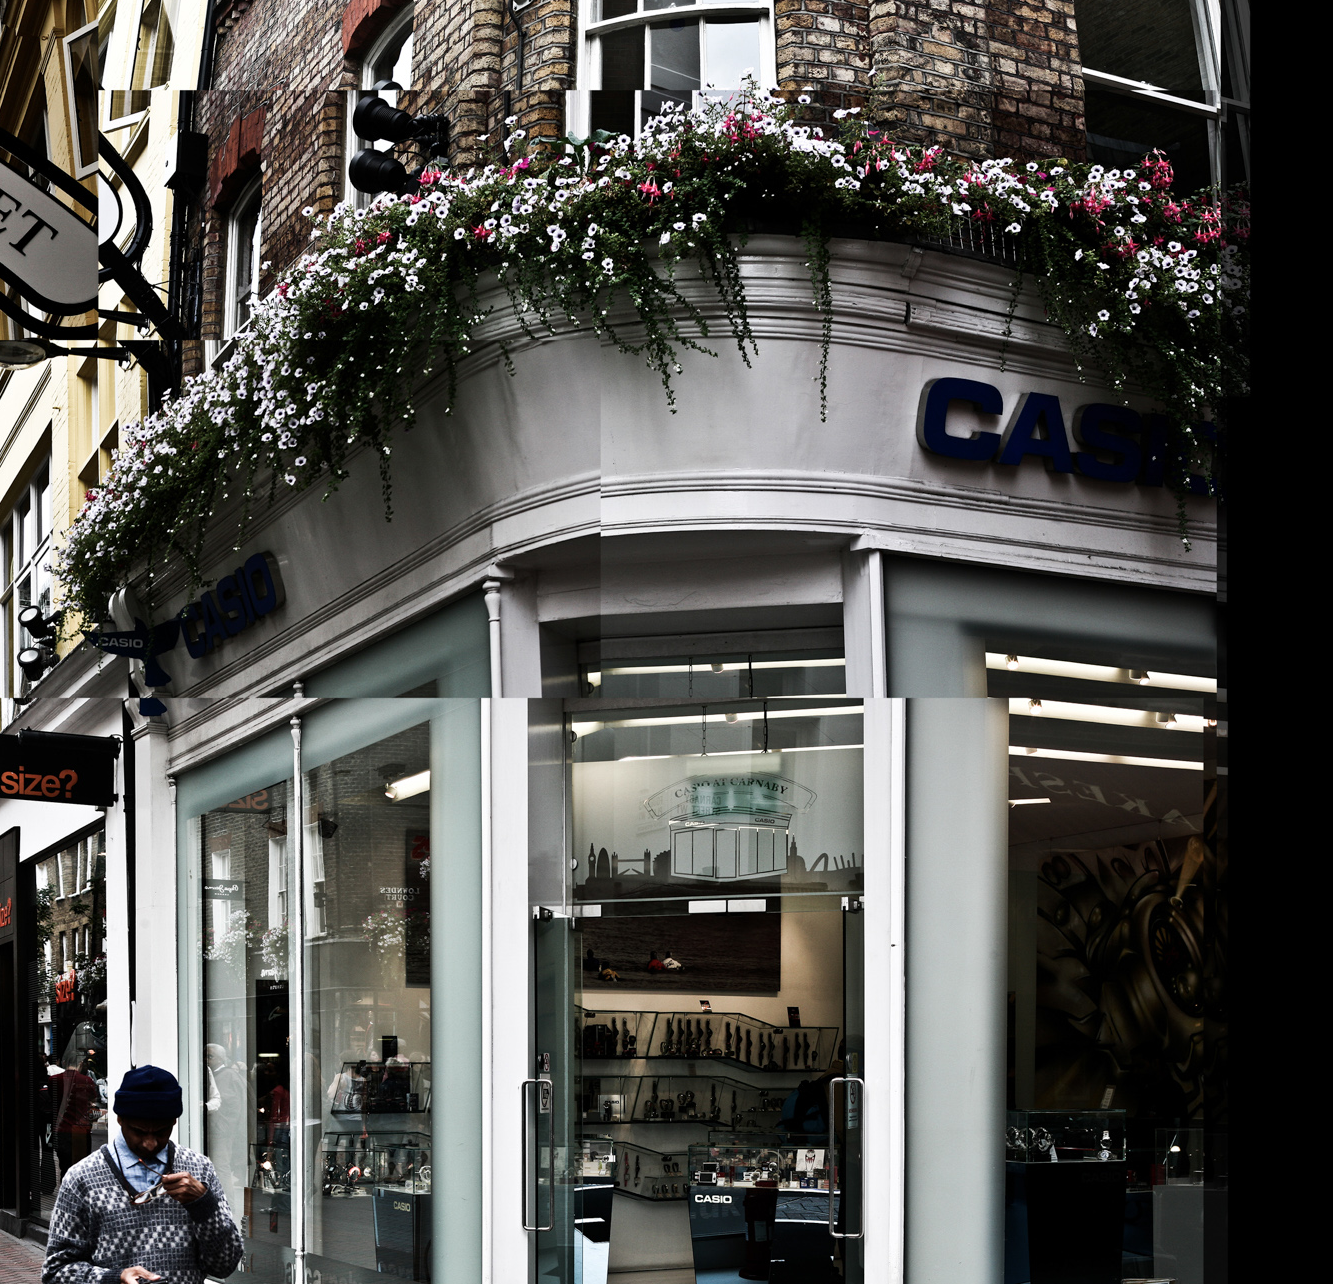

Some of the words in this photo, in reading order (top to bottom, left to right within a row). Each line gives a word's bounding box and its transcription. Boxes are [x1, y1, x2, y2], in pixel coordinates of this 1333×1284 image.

[181, 551, 282, 660] CASIO
[99, 636, 144, 649] CASIO
[0, 765, 79, 799] size?
[729, 776, 789, 795] CARNABY
[393, 1200, 411, 1213] CASIO
[694, 1194, 733, 1204] CASIO
